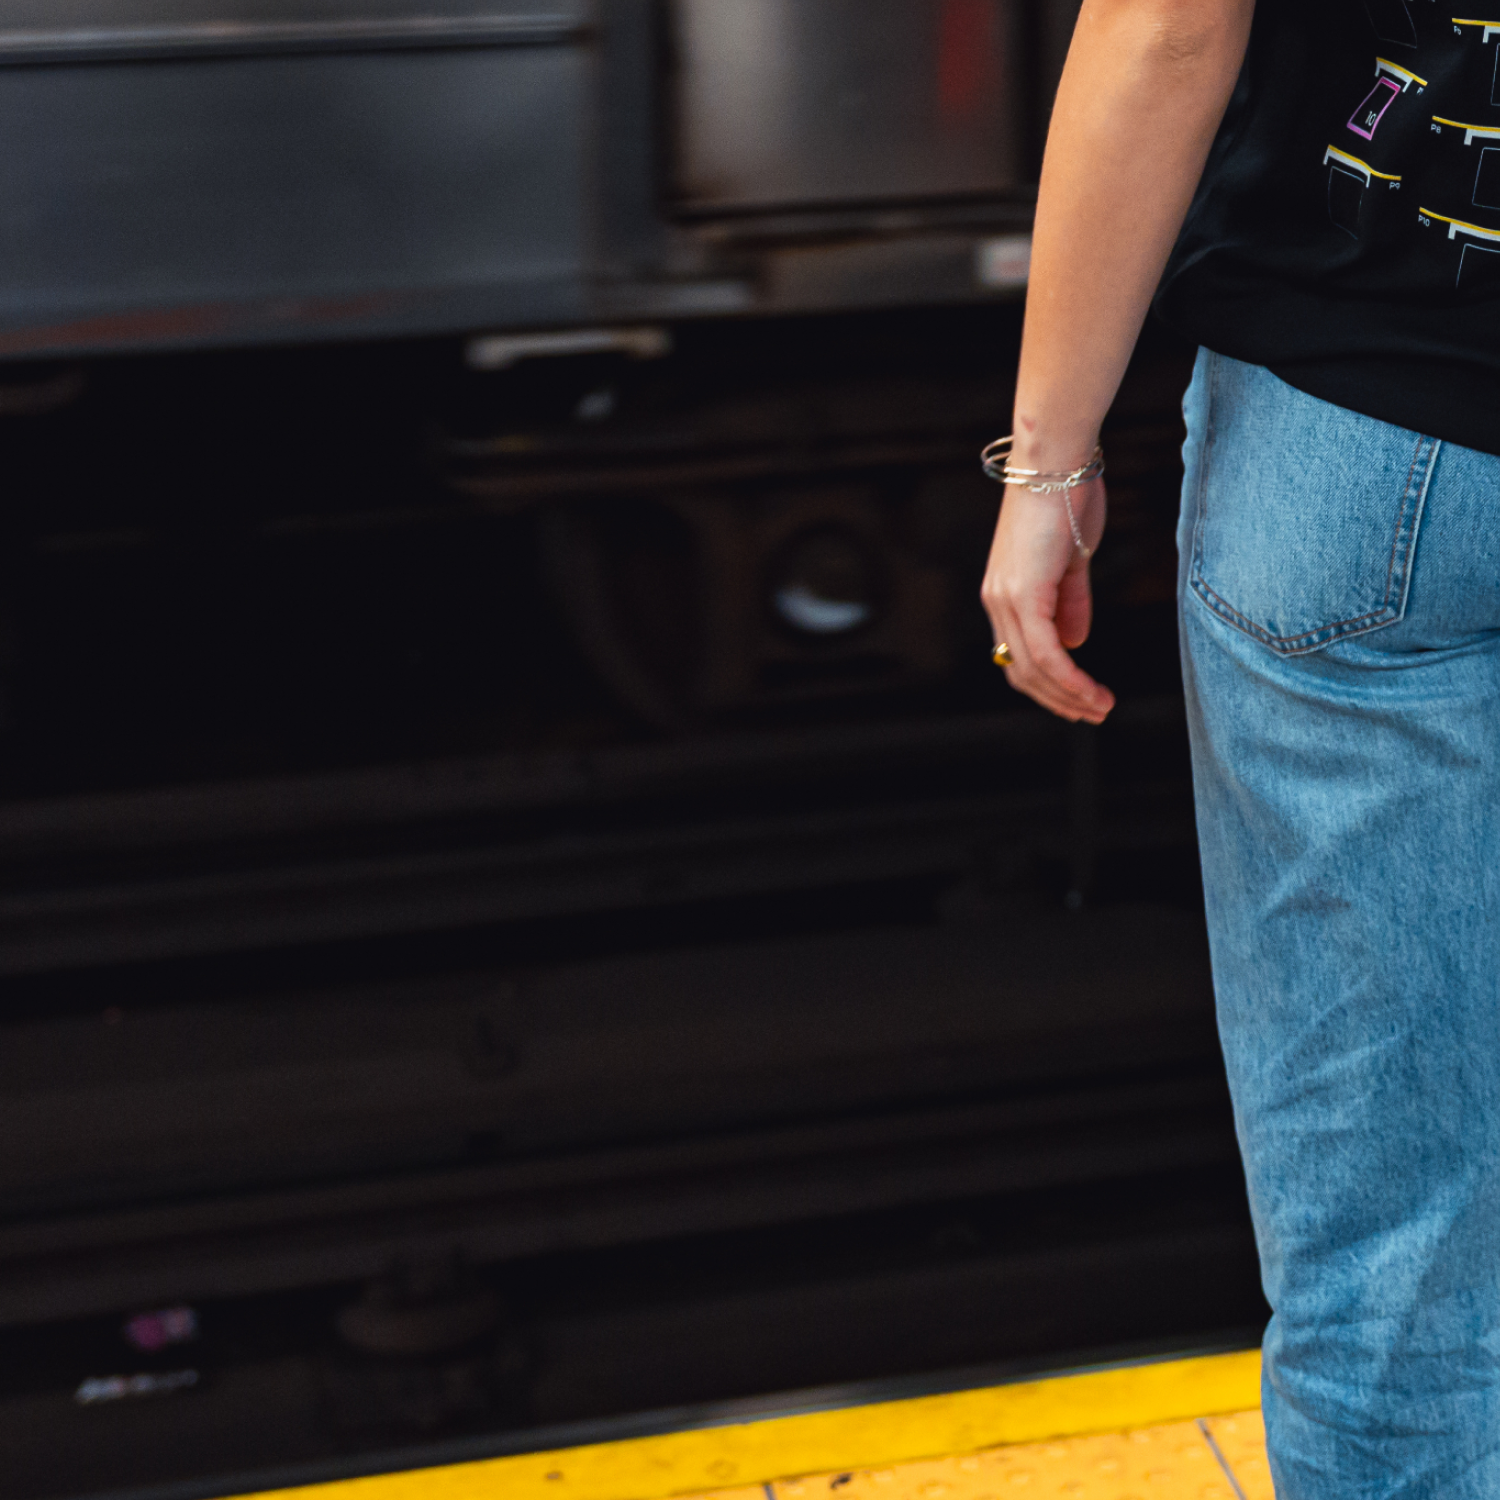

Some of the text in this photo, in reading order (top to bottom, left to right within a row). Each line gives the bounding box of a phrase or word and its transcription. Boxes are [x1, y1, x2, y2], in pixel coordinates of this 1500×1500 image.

[1364, 110, 1378, 128] 10
[1431, 123, 1442, 134] P8
[1389, 181, 1401, 190] P9
[1418, 214, 1430, 227] P10
